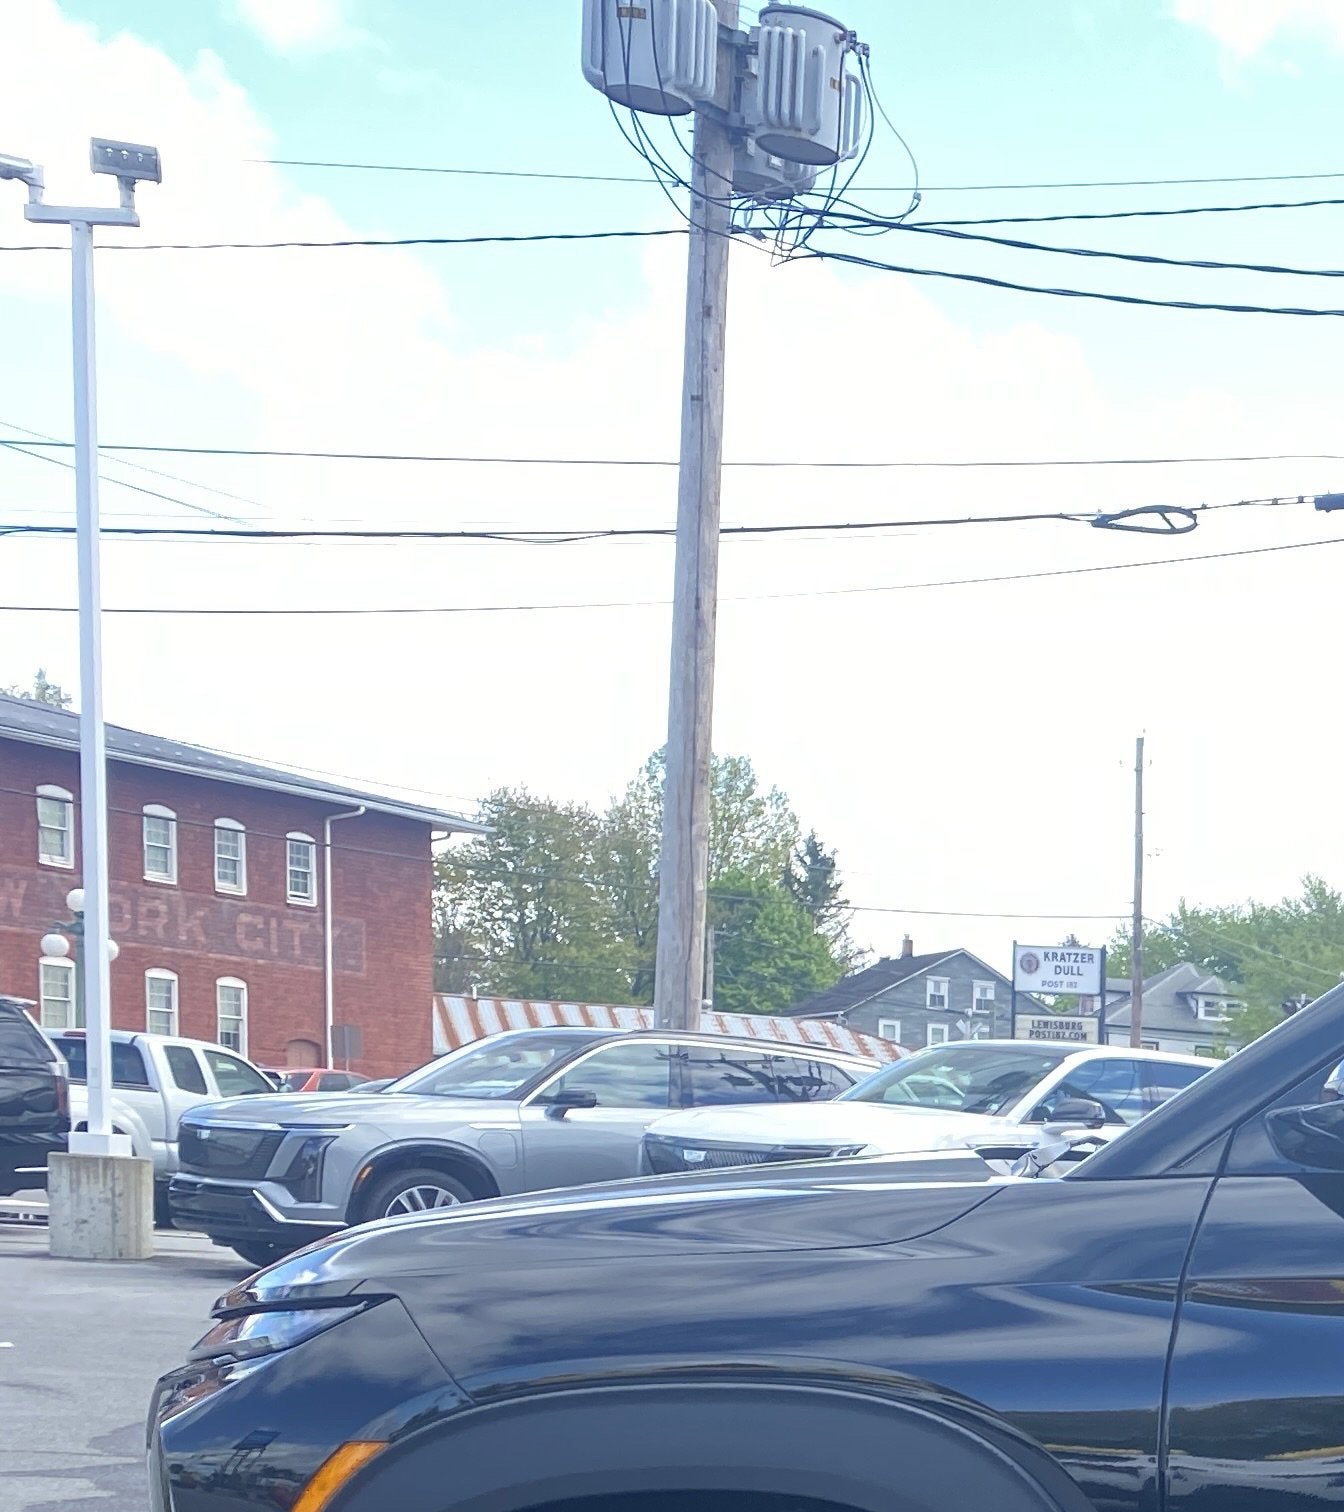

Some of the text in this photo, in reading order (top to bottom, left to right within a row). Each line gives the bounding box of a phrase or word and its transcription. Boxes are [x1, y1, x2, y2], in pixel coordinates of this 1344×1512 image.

[1043, 951, 1094, 964] KRATZER
[1054, 965, 1084, 976] DULL
[1041, 980, 1064, 989] POST
[1031, 1019, 1083, 1031] LEWISBURG
